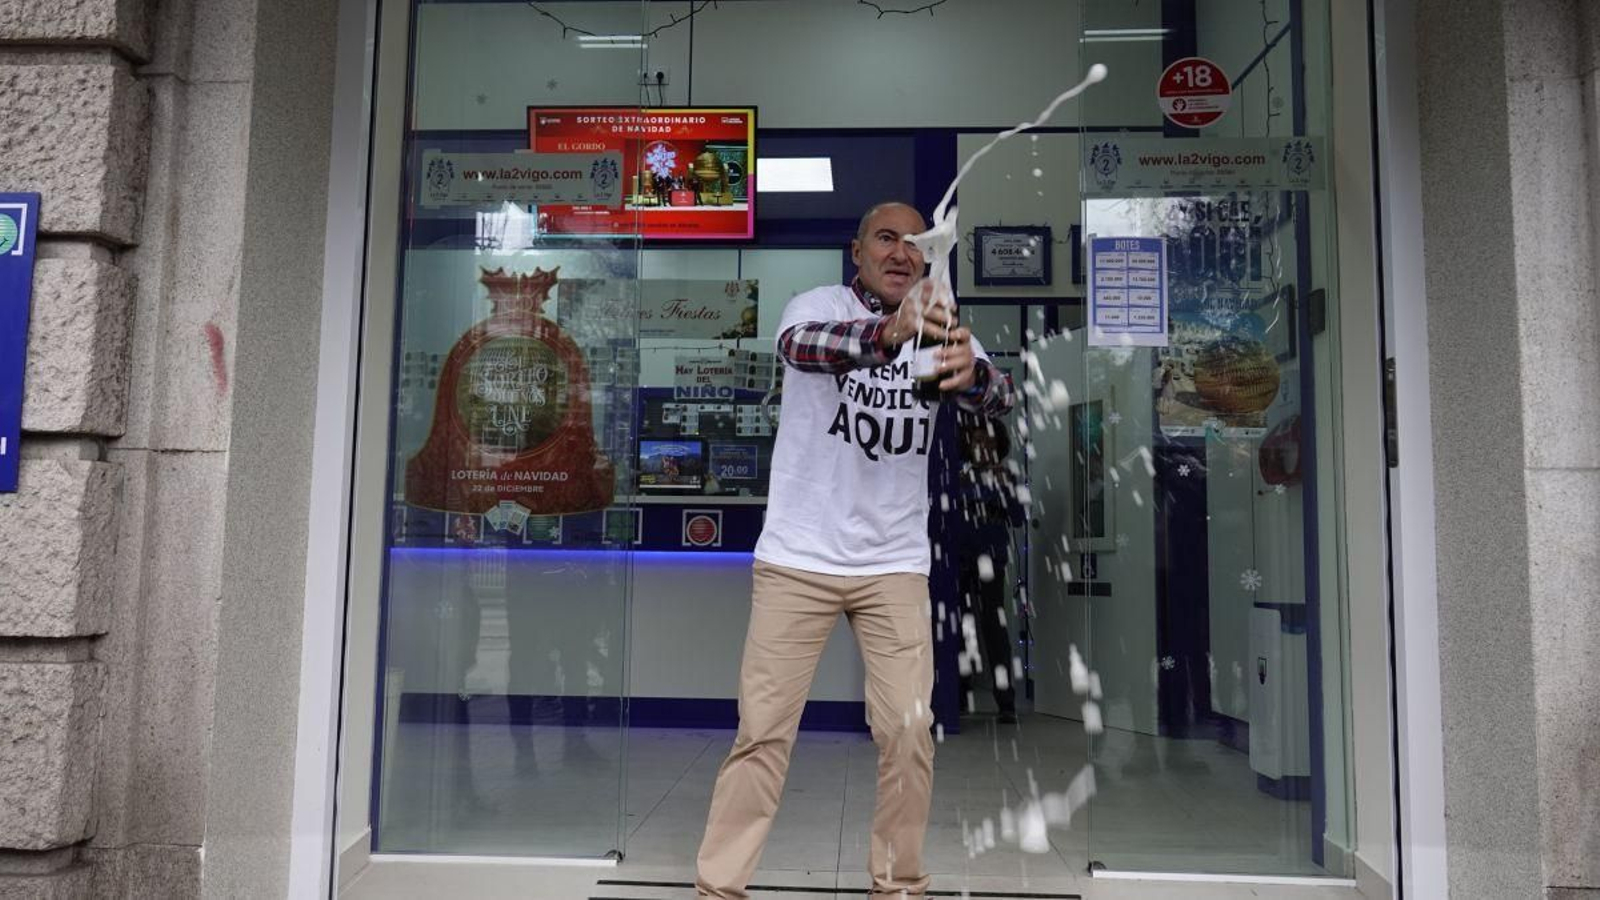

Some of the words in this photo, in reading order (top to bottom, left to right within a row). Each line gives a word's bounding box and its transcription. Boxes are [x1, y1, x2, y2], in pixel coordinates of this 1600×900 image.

[1173, 65, 1212, 87] +18
[1139, 153, 1265, 167] www.la2vigo.com
[463, 168, 582, 182] www.la2vigo.com
[1115, 240, 1141, 250] BOTES
[660, 298, 722, 321] Fiestas
[675, 383, 734, 398] NIÑO
[451, 470, 498, 480] LOTERÍA
[514, 471, 569, 482] NAVIDAD
[497, 485, 545, 493] DICIEMBRE
